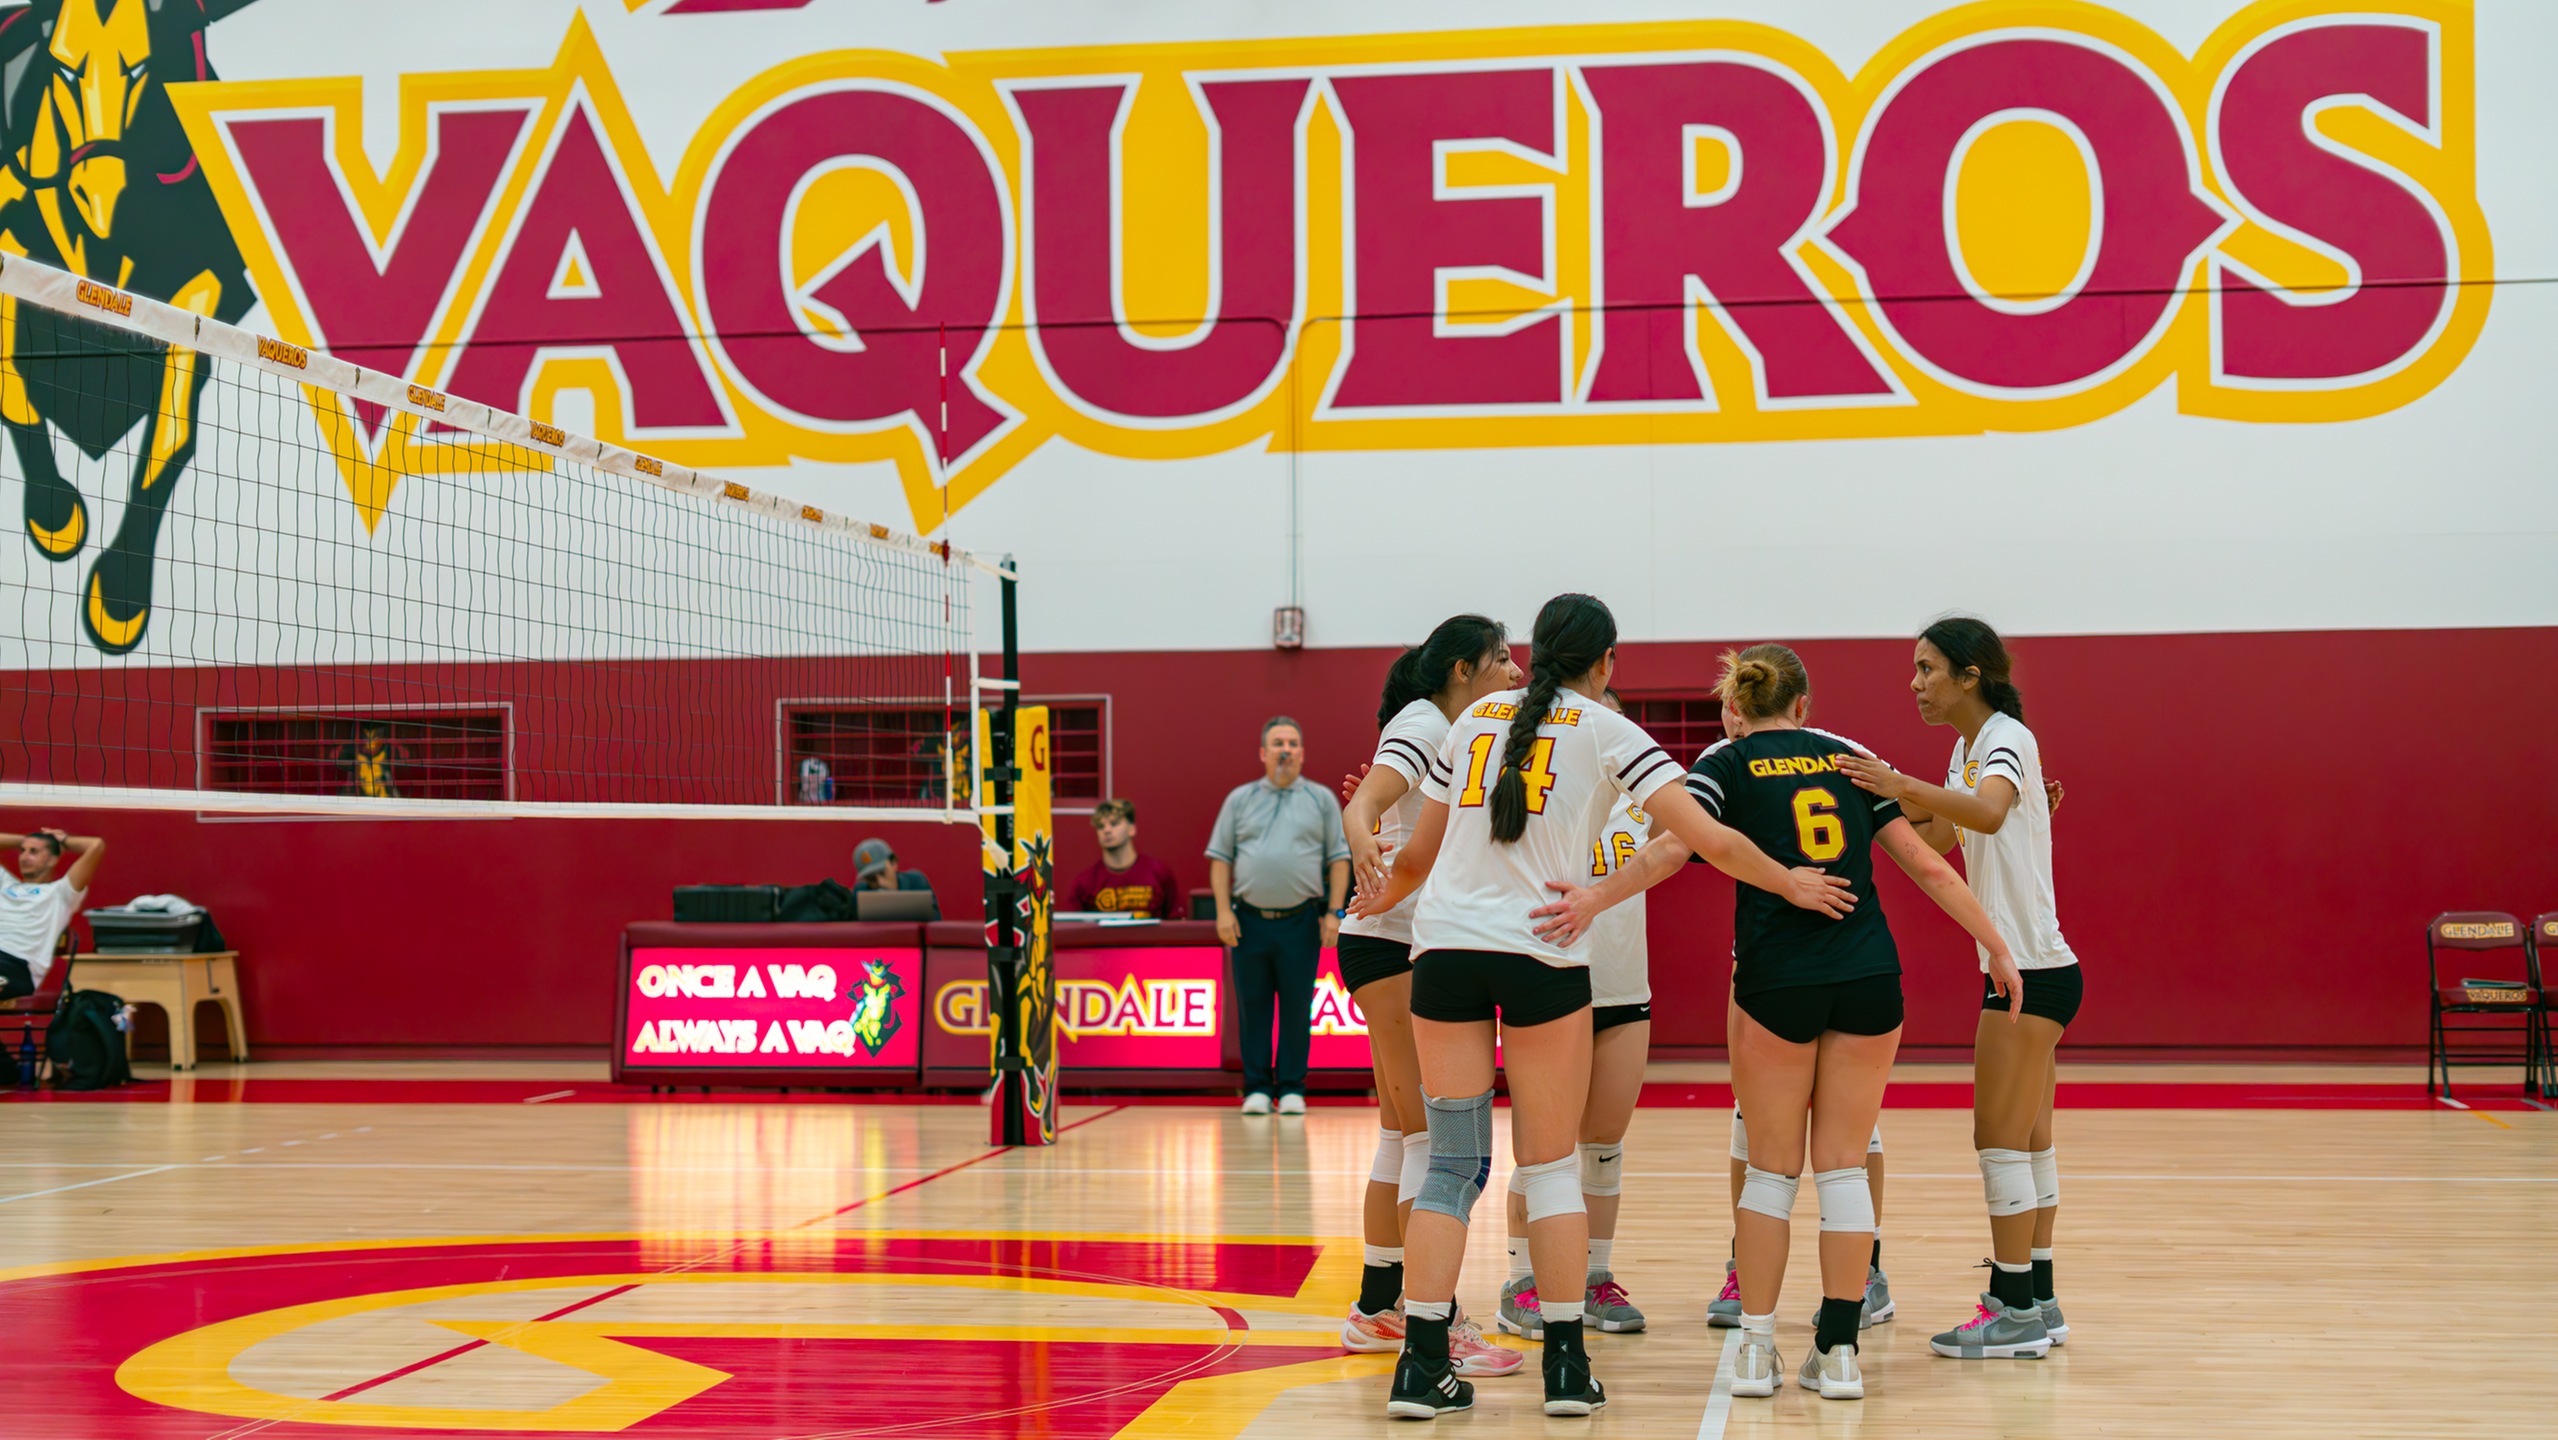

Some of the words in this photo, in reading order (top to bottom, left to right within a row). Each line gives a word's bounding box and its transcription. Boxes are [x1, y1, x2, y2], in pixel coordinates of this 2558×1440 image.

[200, 12, 2468, 482] VAQUEROS
[76, 279, 133, 317] GLENDALE
[256, 334, 308, 369] VAQUEROS
[407, 384, 446, 412] GLENDALE
[1031, 724, 1045, 771] G
[1748, 753, 1850, 778] GLENDAL
[1458, 733, 1557, 815] 14
[1791, 786, 1848, 863] 6
[1591, 831, 1637, 876] 16
[2440, 922, 2515, 939] GLENDALE
[636, 964, 736, 998] ONCE
[736, 965, 767, 998] A
[767, 964, 837, 1002] VAQ
[2465, 988, 2528, 1003] VAQUEROS
[632, 1019, 758, 1054] ALWAYS
[759, 1020, 790, 1053] A
[786, 1020, 856, 1057] VAQ
